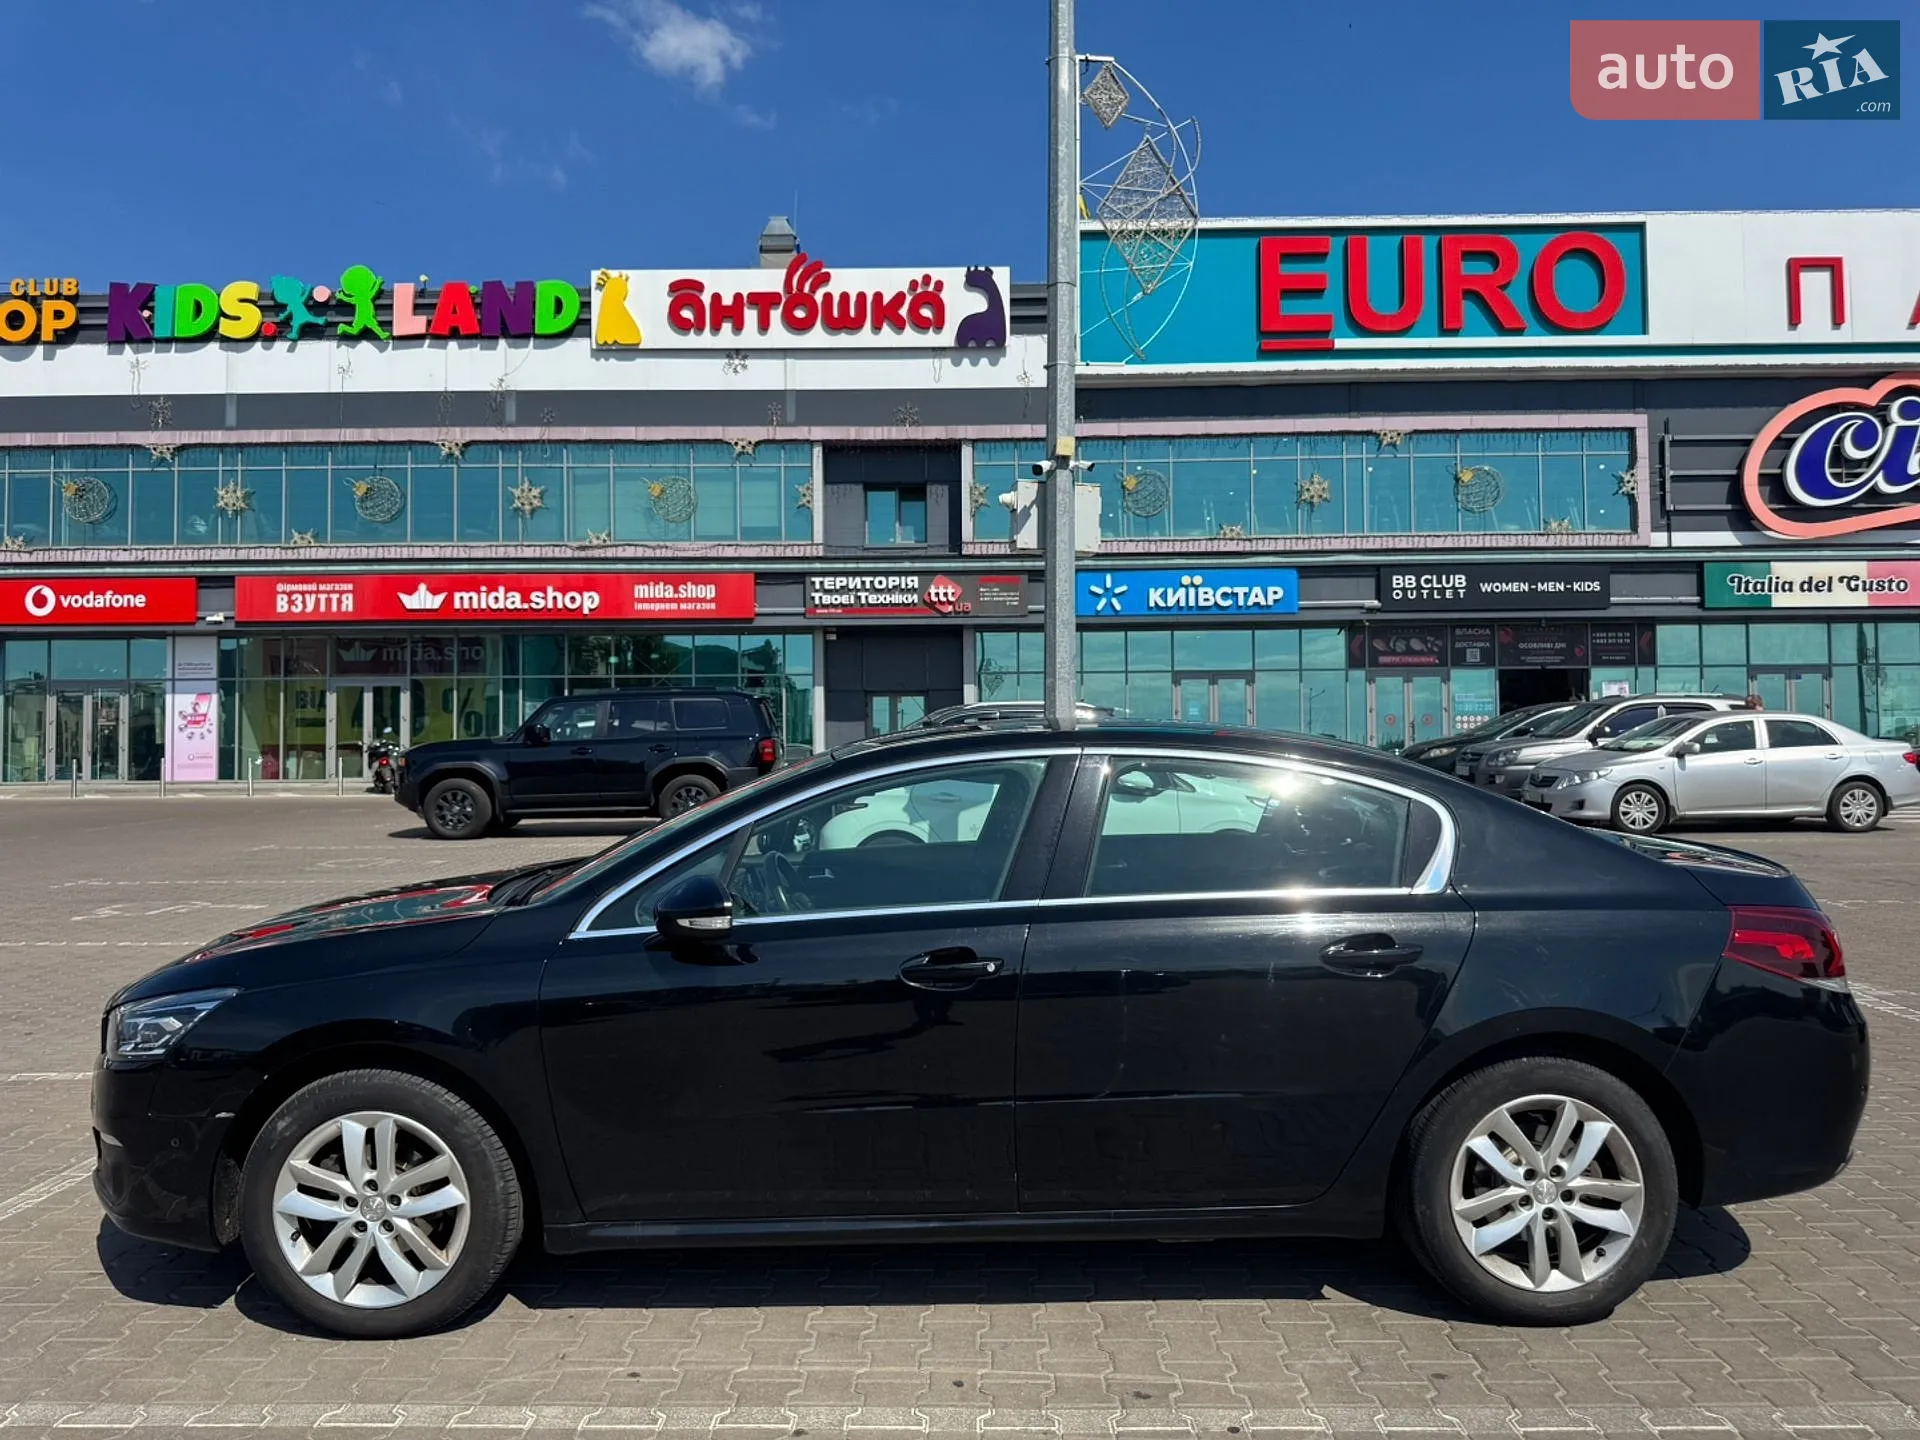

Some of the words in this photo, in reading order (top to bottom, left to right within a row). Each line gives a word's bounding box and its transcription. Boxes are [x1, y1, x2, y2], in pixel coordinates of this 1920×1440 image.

[10, 278, 78, 296] CLUB
[1259, 231, 1625, 333] EURO
[393, 280, 581, 337] LAND
[318, 583, 354, 592] магазин
[811, 576, 919, 590] ТЕРИТОРІЯ
[1392, 575, 1417, 588] BB
[1420, 574, 1467, 588] CLUB
[1727, 575, 1794, 593] Italia
[1799, 576, 1833, 593] del
[1837, 575, 1909, 593] Gusto
[60, 590, 146, 609] vodafone
[633, 581, 716, 600] mida.shop
[811, 592, 855, 605] Твоєї
[857, 592, 919, 604] Техніки
[1149, 575, 1285, 607] КИЇВСТАР
[1392, 589, 1467, 600] OUTLET
[276, 593, 354, 613] ВЗУТТЯ
[453, 586, 600, 614] mida.shop
[679, 602, 716, 611] магазин
